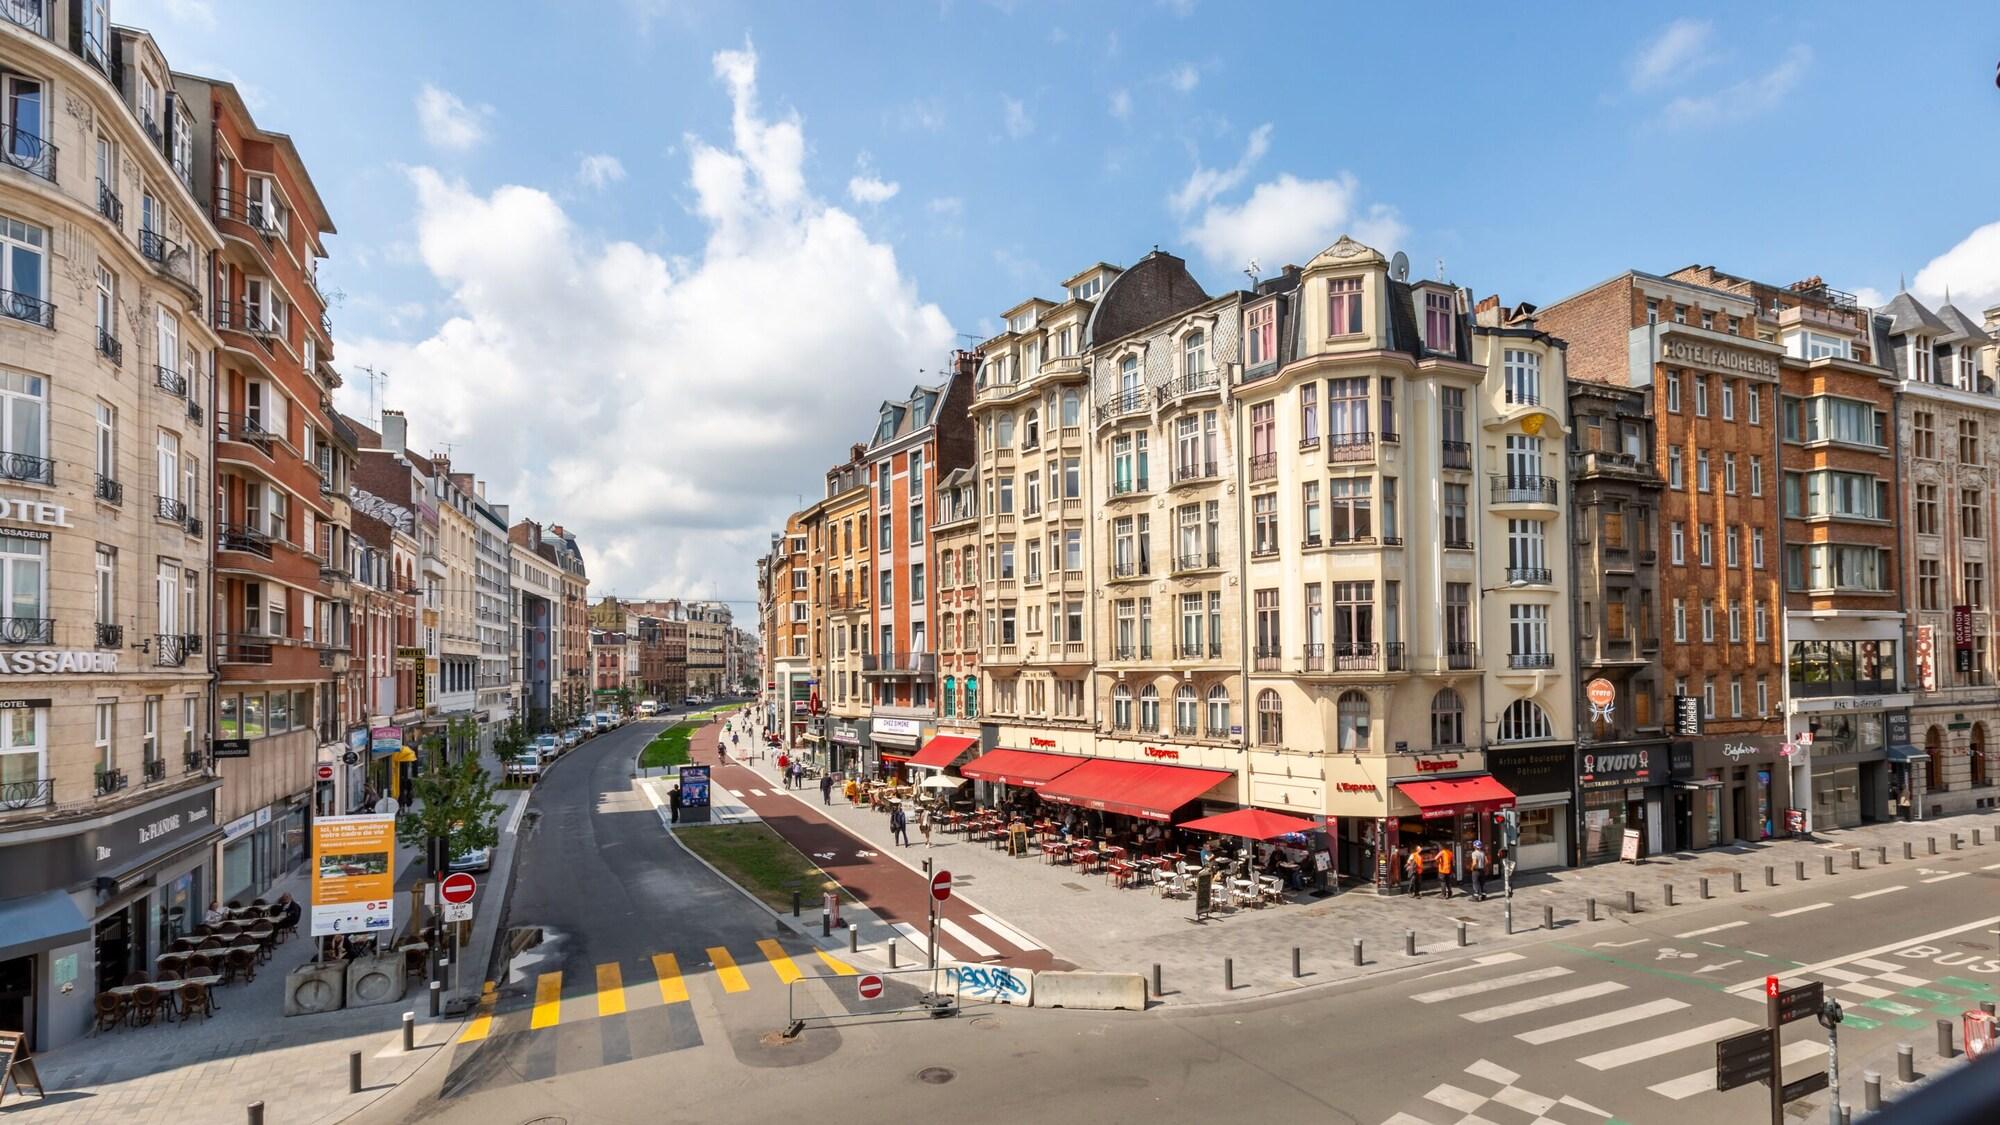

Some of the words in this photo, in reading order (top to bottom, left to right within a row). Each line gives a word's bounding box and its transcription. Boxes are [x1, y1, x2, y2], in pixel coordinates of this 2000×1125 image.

[1663, 341, 1707, 364] HOTEL
[1711, 349, 1778, 376] FAIDHERBE
[1956, 611, 1964, 645] LOCATION
[1963, 613, 1971, 642] BUREAUX
[399, 649, 423, 657] HOTEL
[1679, 697, 1688, 734] HOTEL
[1688, 697, 1698, 734] FAIDHERBE
[1144, 746, 1180, 760] L'Express
[1416, 759, 1459, 774] L'Express
[1596, 753, 1638, 774] KYOTO
[1336, 782, 1377, 796] L'Express
[1893, 945, 2000, 973] BUS
